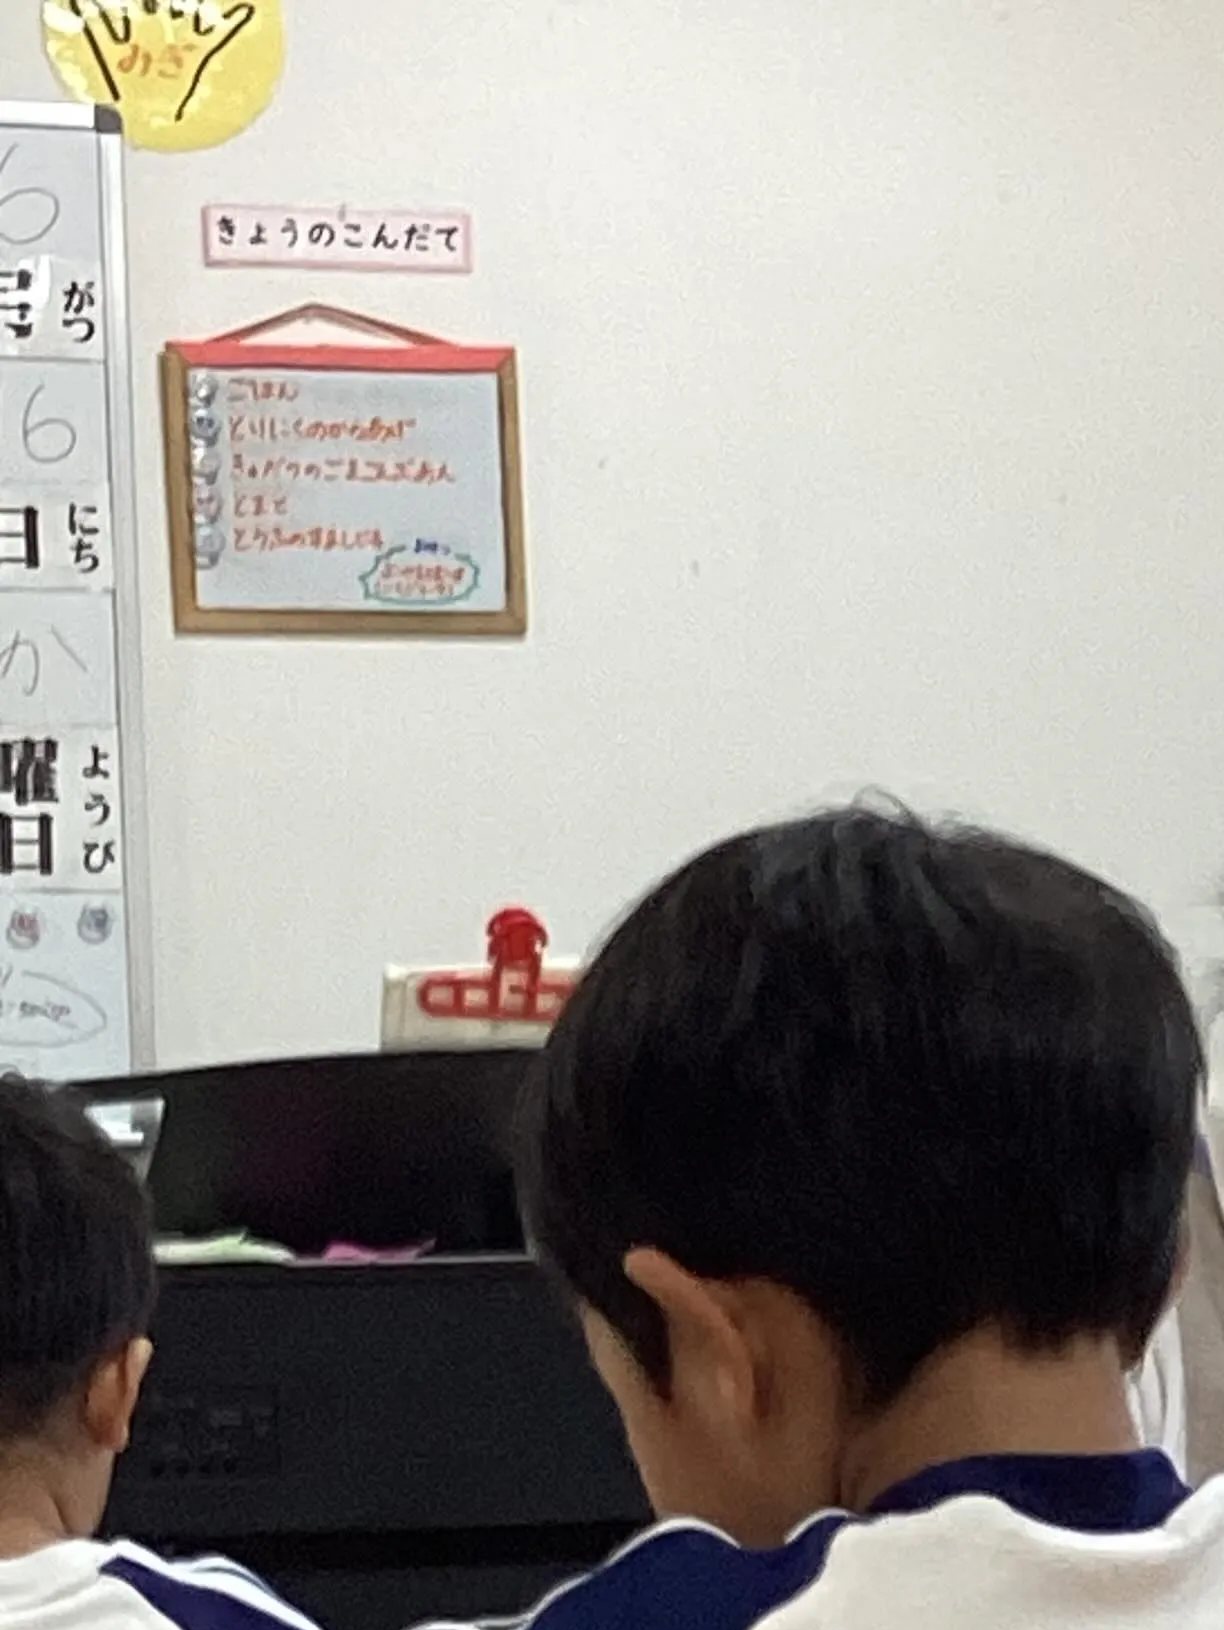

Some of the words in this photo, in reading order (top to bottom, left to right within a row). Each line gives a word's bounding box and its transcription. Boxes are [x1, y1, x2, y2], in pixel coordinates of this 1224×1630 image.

[216, 215, 461, 253] きょうのこんだて
[61, 280, 96, 345] がつ
[22, 381, 76, 464] 6
[68, 502, 99, 575] にち
[0, 737, 59, 876] 曜日
[82, 744, 116, 874] ようび
